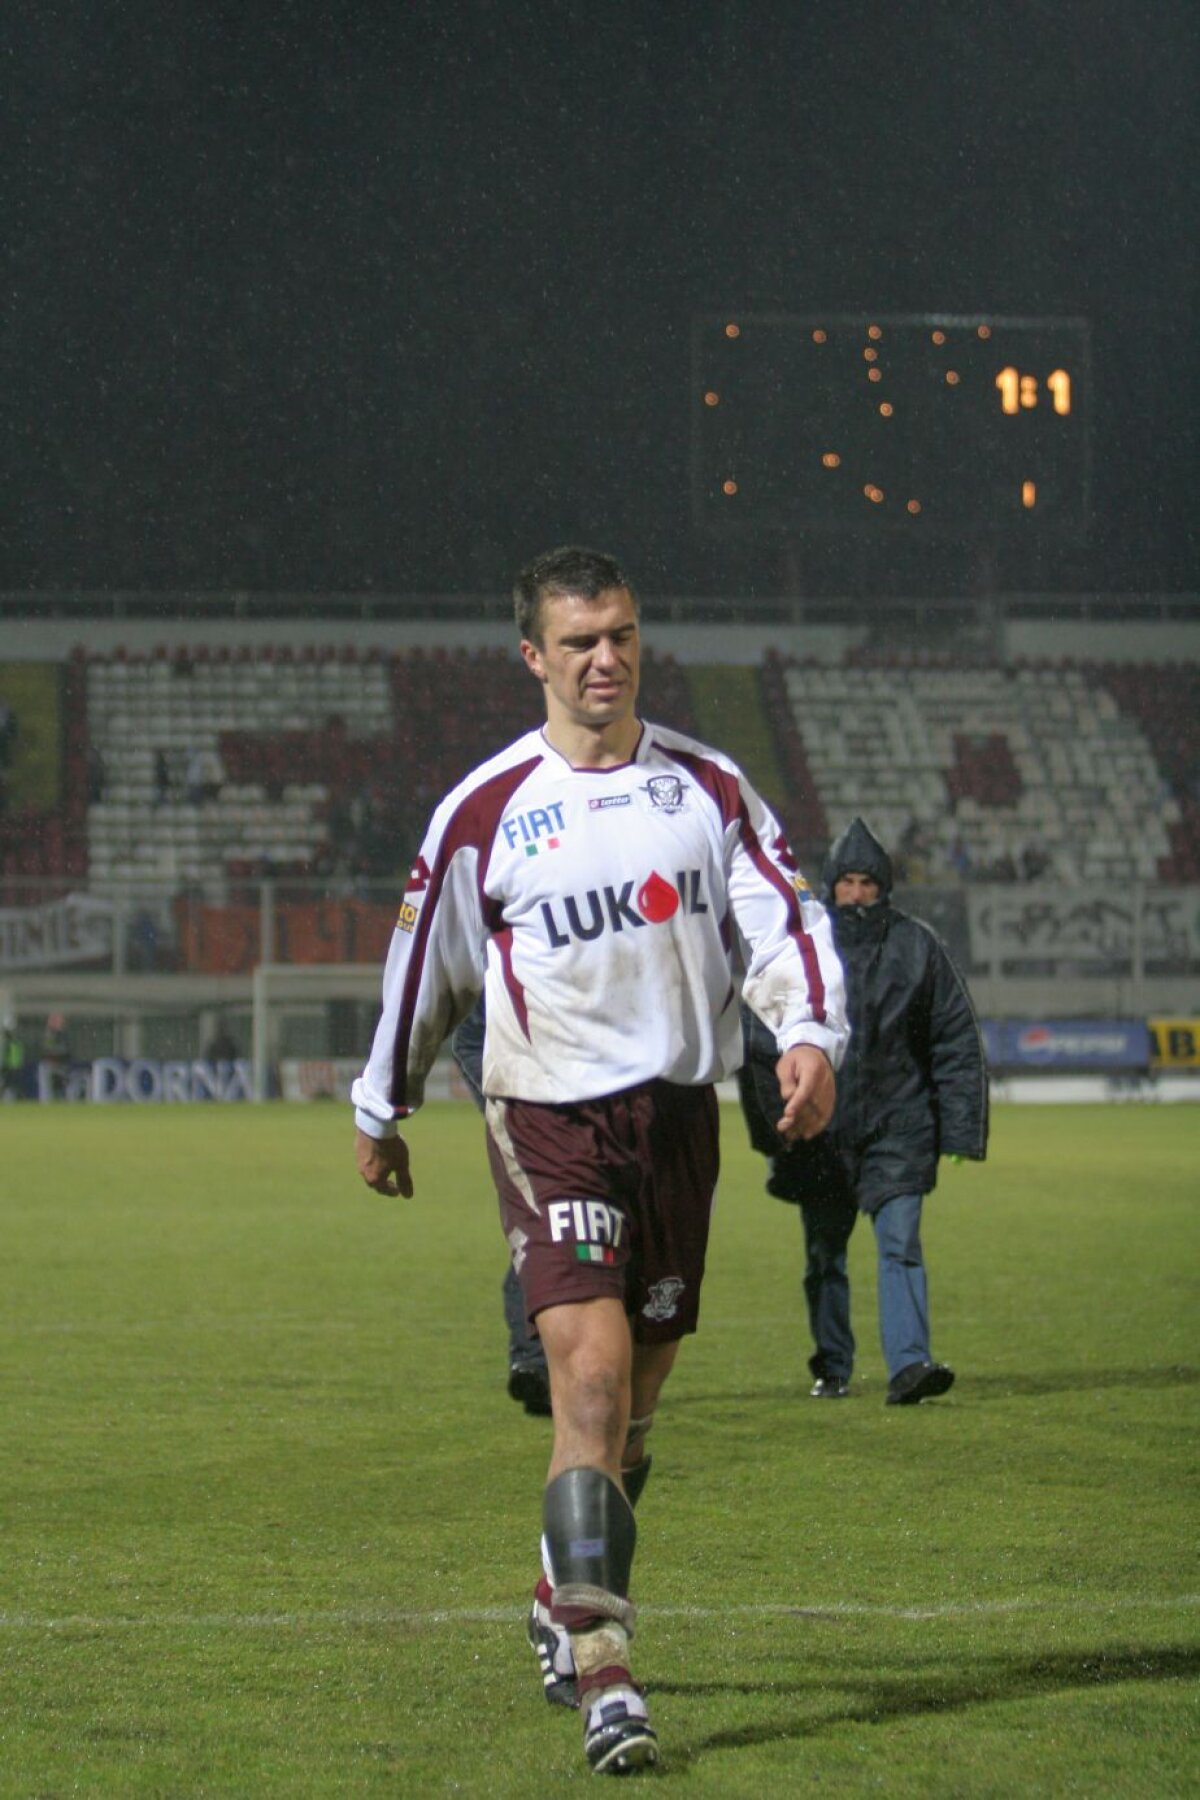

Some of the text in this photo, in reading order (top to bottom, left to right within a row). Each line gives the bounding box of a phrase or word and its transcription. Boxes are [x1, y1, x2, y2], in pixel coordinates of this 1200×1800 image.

[996, 366, 1071, 416] 1:1
[502, 801, 566, 850] FIAT
[547, 1201, 625, 1248] FIAT
